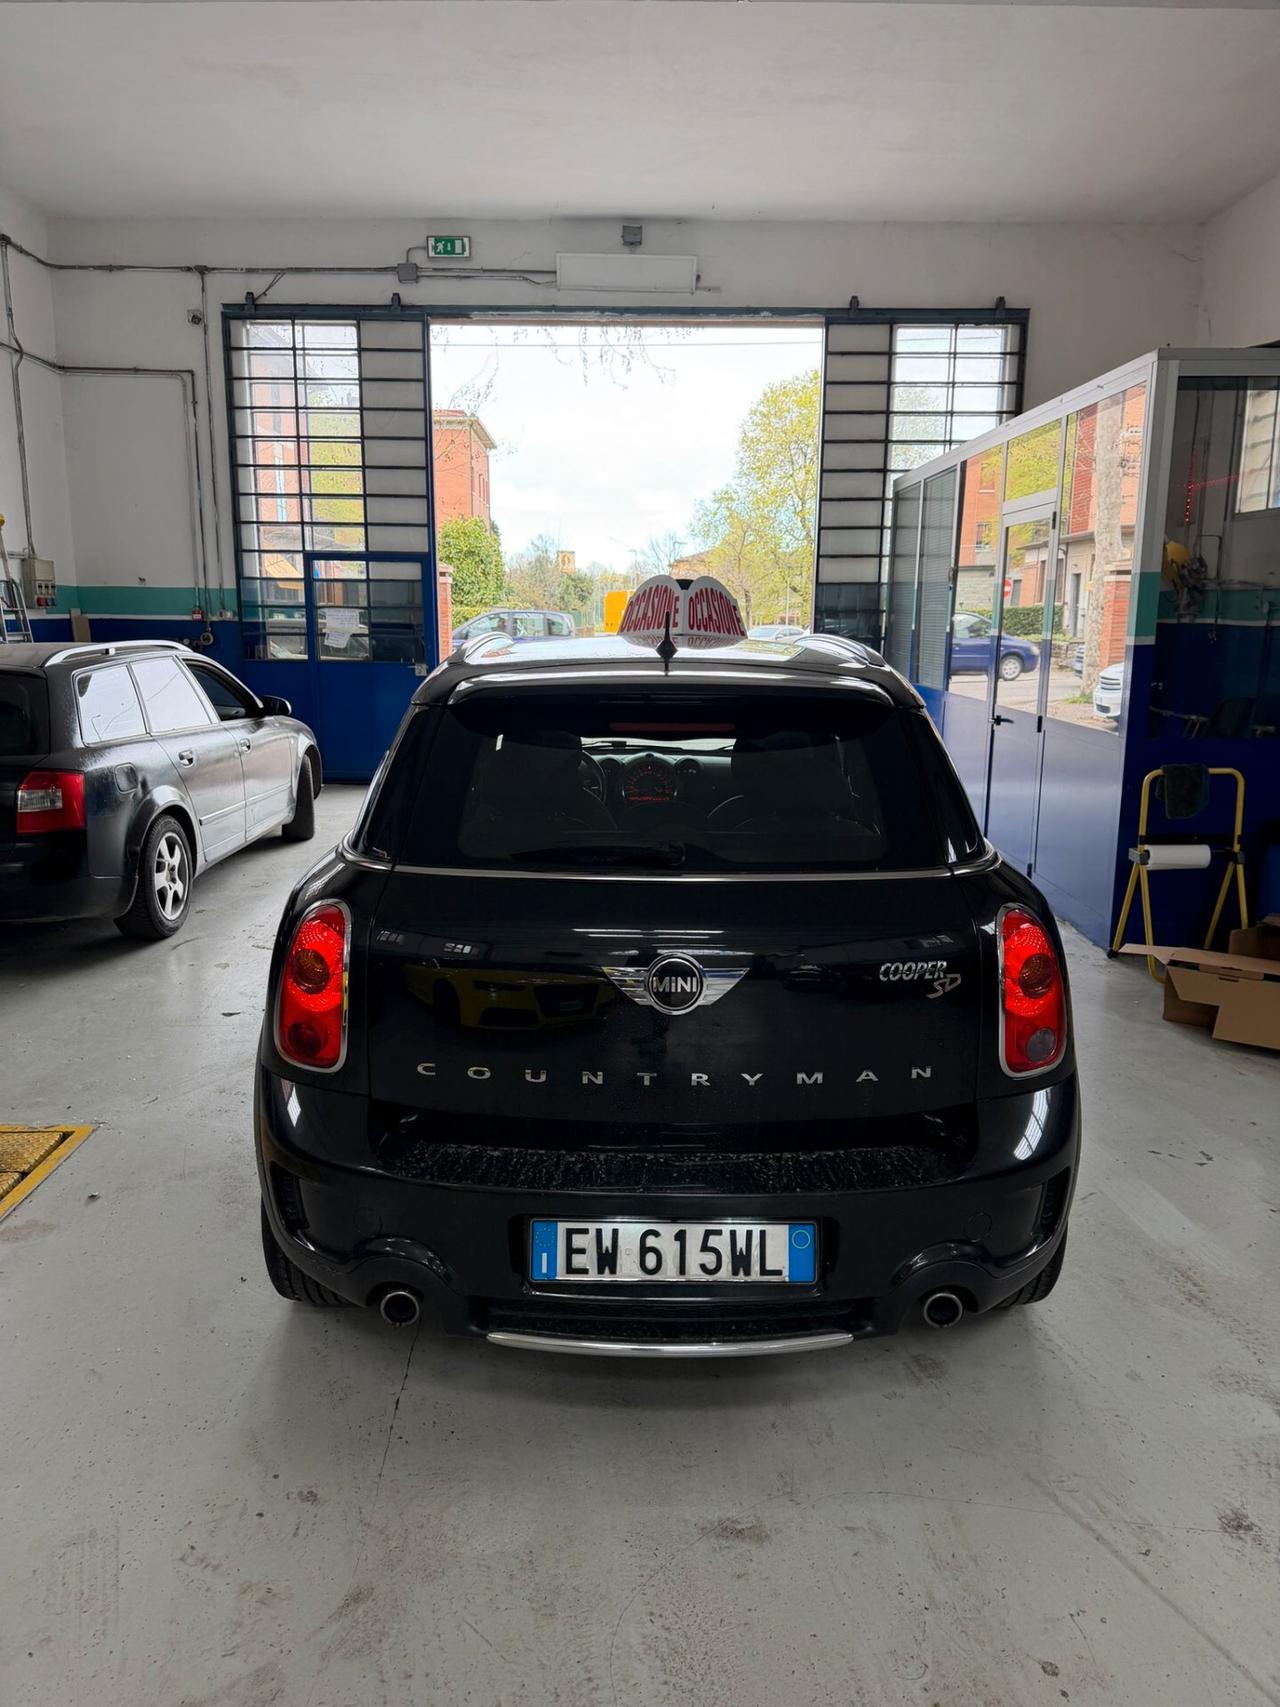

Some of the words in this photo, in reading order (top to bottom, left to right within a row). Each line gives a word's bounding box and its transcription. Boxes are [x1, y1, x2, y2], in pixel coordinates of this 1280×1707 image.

[620, 584, 680, 633] OCCASIONE
[688, 587, 745, 636] OCCASIONE
[879, 961, 947, 981] COOPER
[653, 977, 697, 993] MINI
[926, 974, 962, 999] SD
[416, 1062, 933, 1087] COUNTRYMAN
[565, 1228, 620, 1276] EW
[639, 1228, 783, 1277] 615WL
